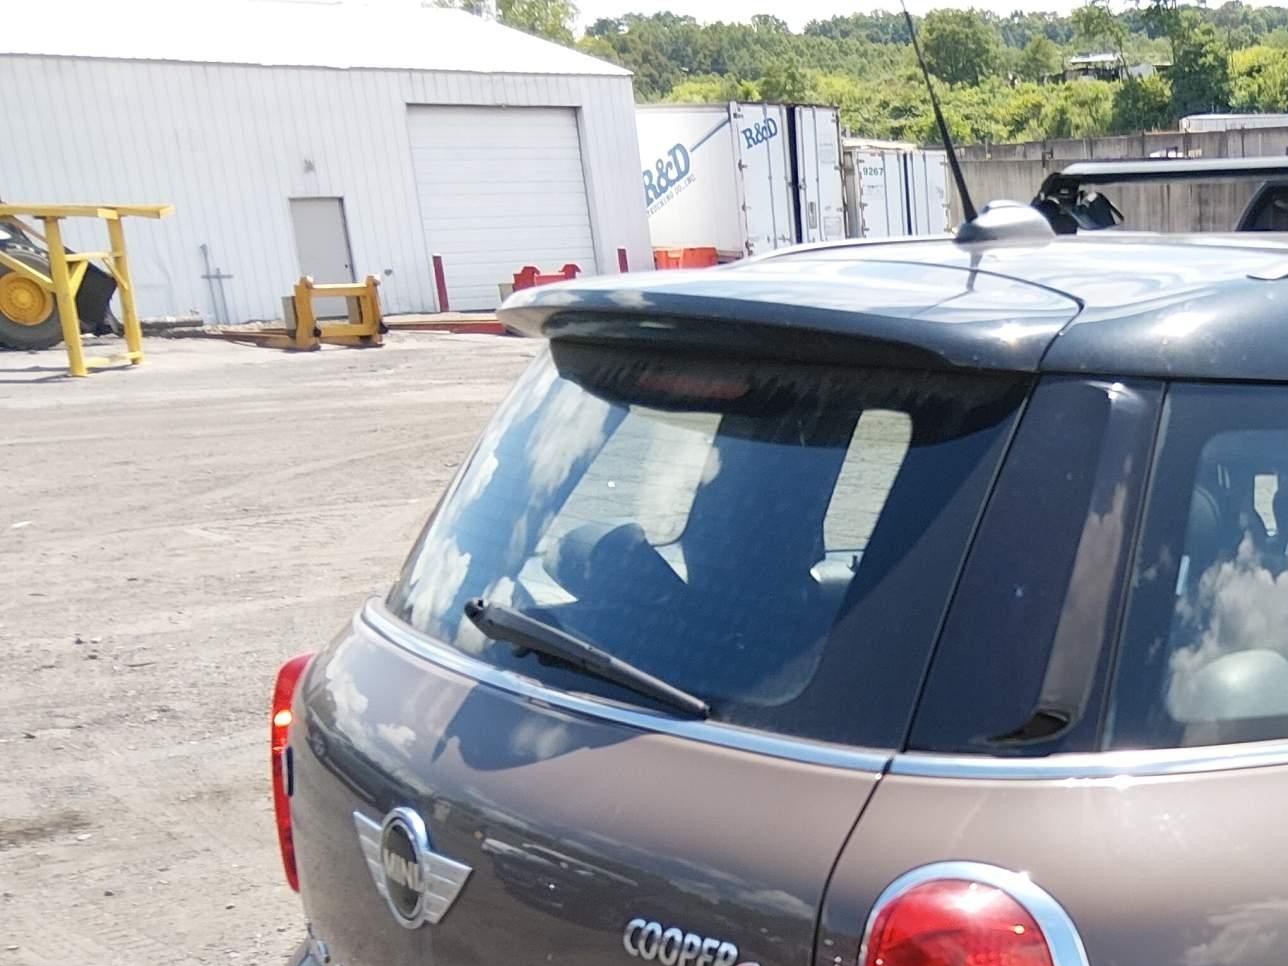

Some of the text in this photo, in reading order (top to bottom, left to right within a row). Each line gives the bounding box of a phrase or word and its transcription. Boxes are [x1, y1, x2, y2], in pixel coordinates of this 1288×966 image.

[741, 118, 778, 149] R&D
[643, 143, 690, 207] R&D
[863, 167, 884, 176] 9267
[383, 848, 424, 892] MINI
